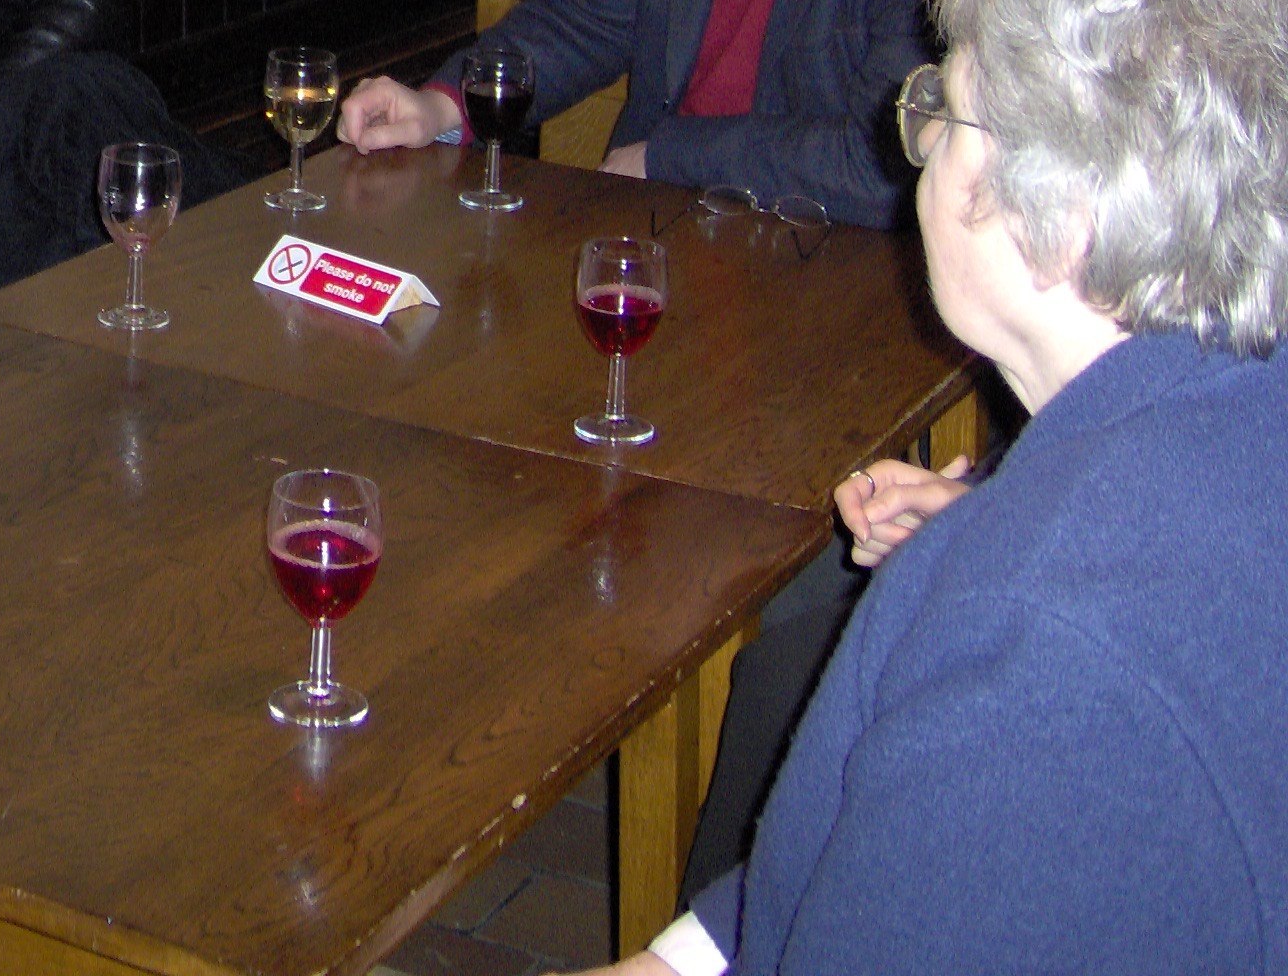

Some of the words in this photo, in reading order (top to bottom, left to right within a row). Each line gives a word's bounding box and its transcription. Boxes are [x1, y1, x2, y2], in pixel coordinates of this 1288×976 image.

[314, 259, 354, 281] Please
[356, 274, 372, 288] do
[372, 281, 396, 295] not
[323, 282, 365, 304] smoke
